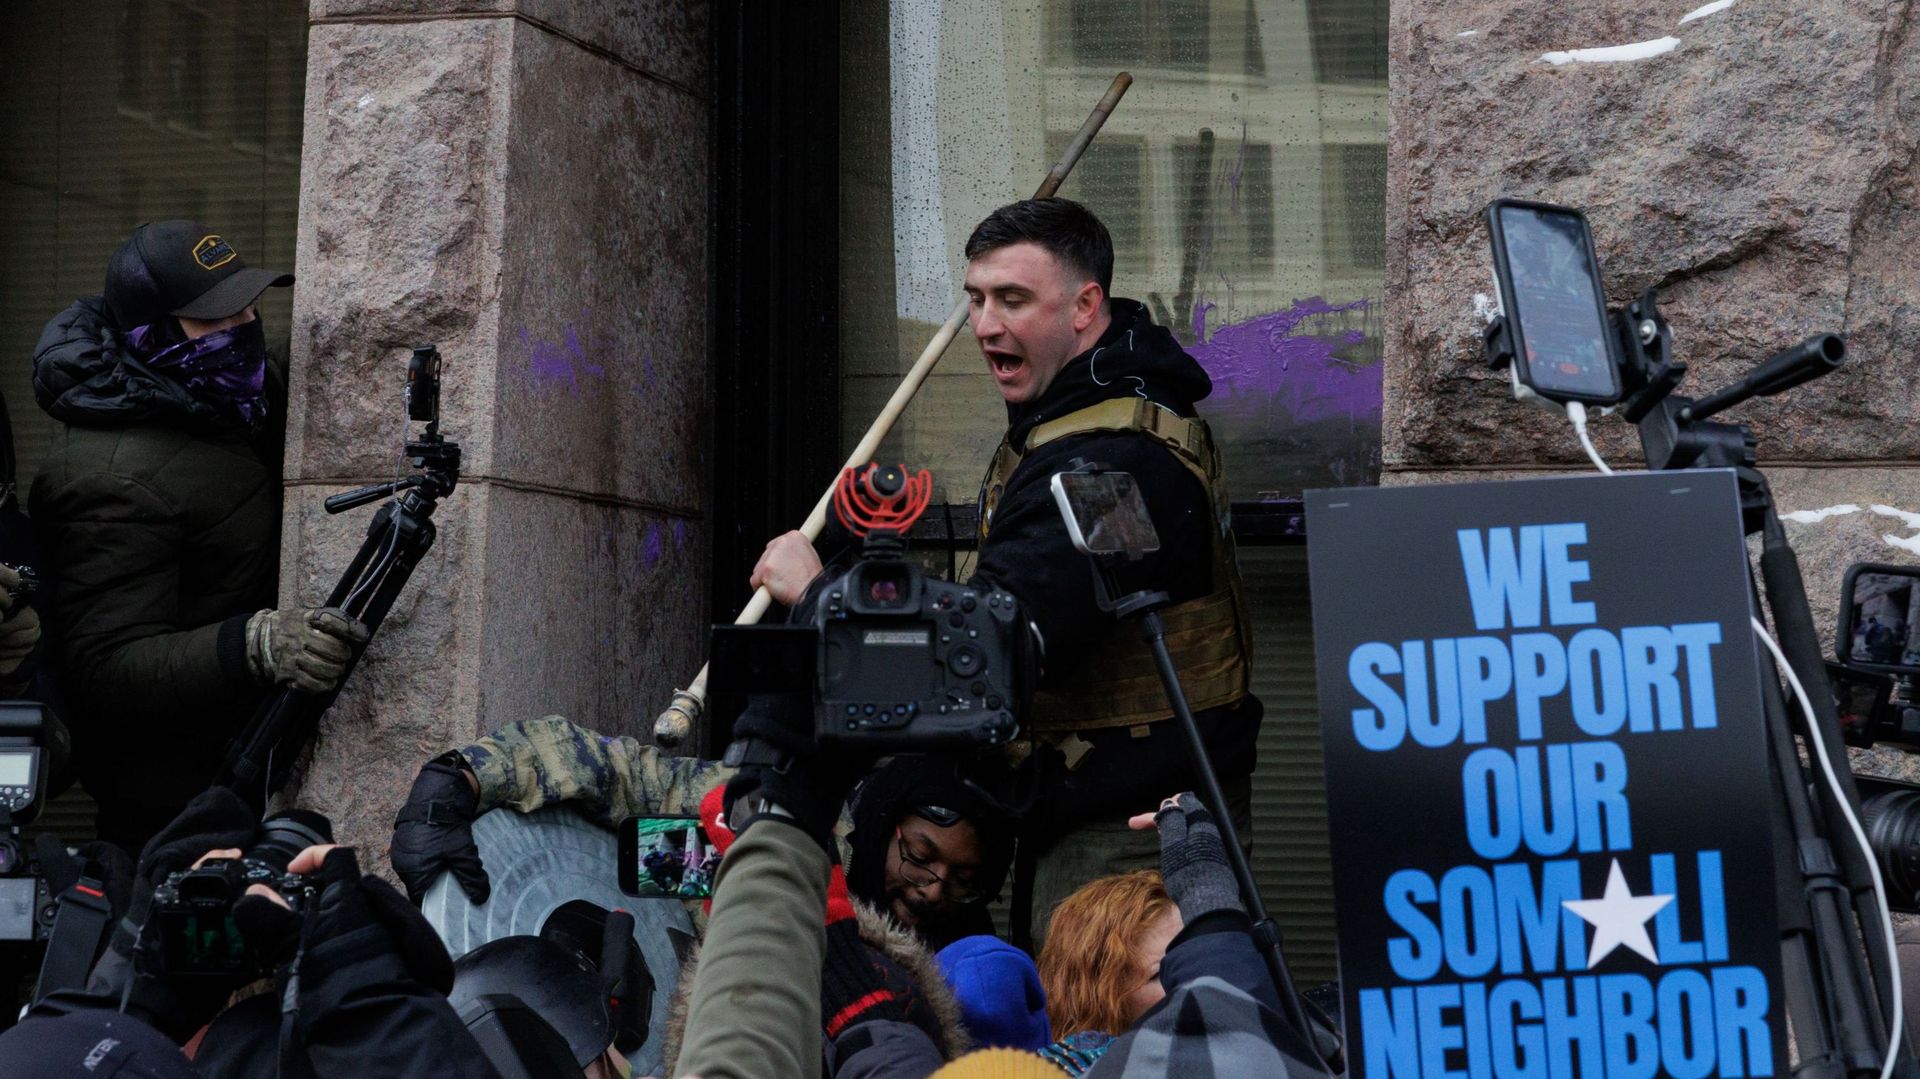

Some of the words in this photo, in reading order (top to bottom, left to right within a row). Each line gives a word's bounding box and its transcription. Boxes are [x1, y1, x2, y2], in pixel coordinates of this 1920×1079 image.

[1457, 522, 1597, 630] WE
[1348, 622, 1722, 752] SUPPORT
[1461, 741, 1632, 860] OUR
[1383, 850, 1730, 982] SOMLI
[1359, 966, 1774, 1079] NEIGHBOR
